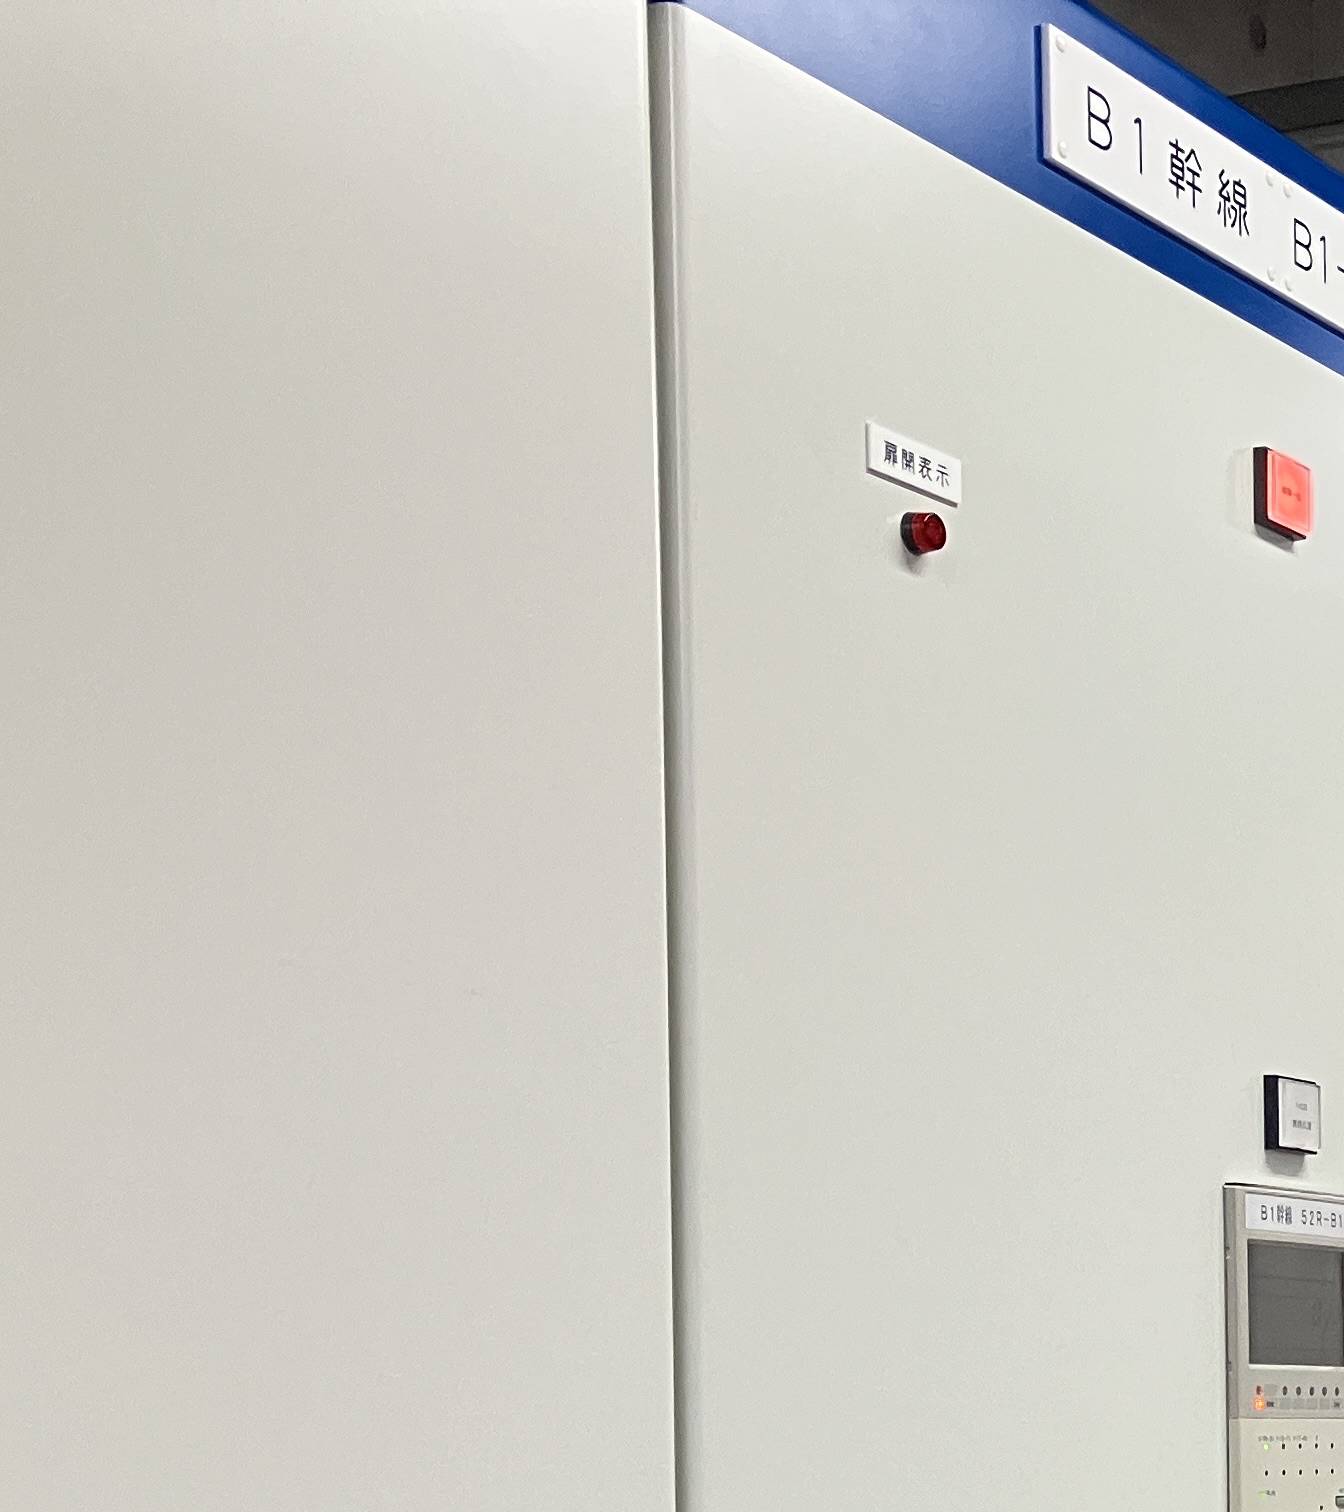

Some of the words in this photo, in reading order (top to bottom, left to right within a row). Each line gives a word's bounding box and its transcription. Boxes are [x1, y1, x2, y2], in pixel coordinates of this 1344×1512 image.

[1086, 85, 1250, 238] B1幹線
[883, 439, 950, 488] 扉開表示
[1300, 1209, 1343, 1229] 52R-B1
